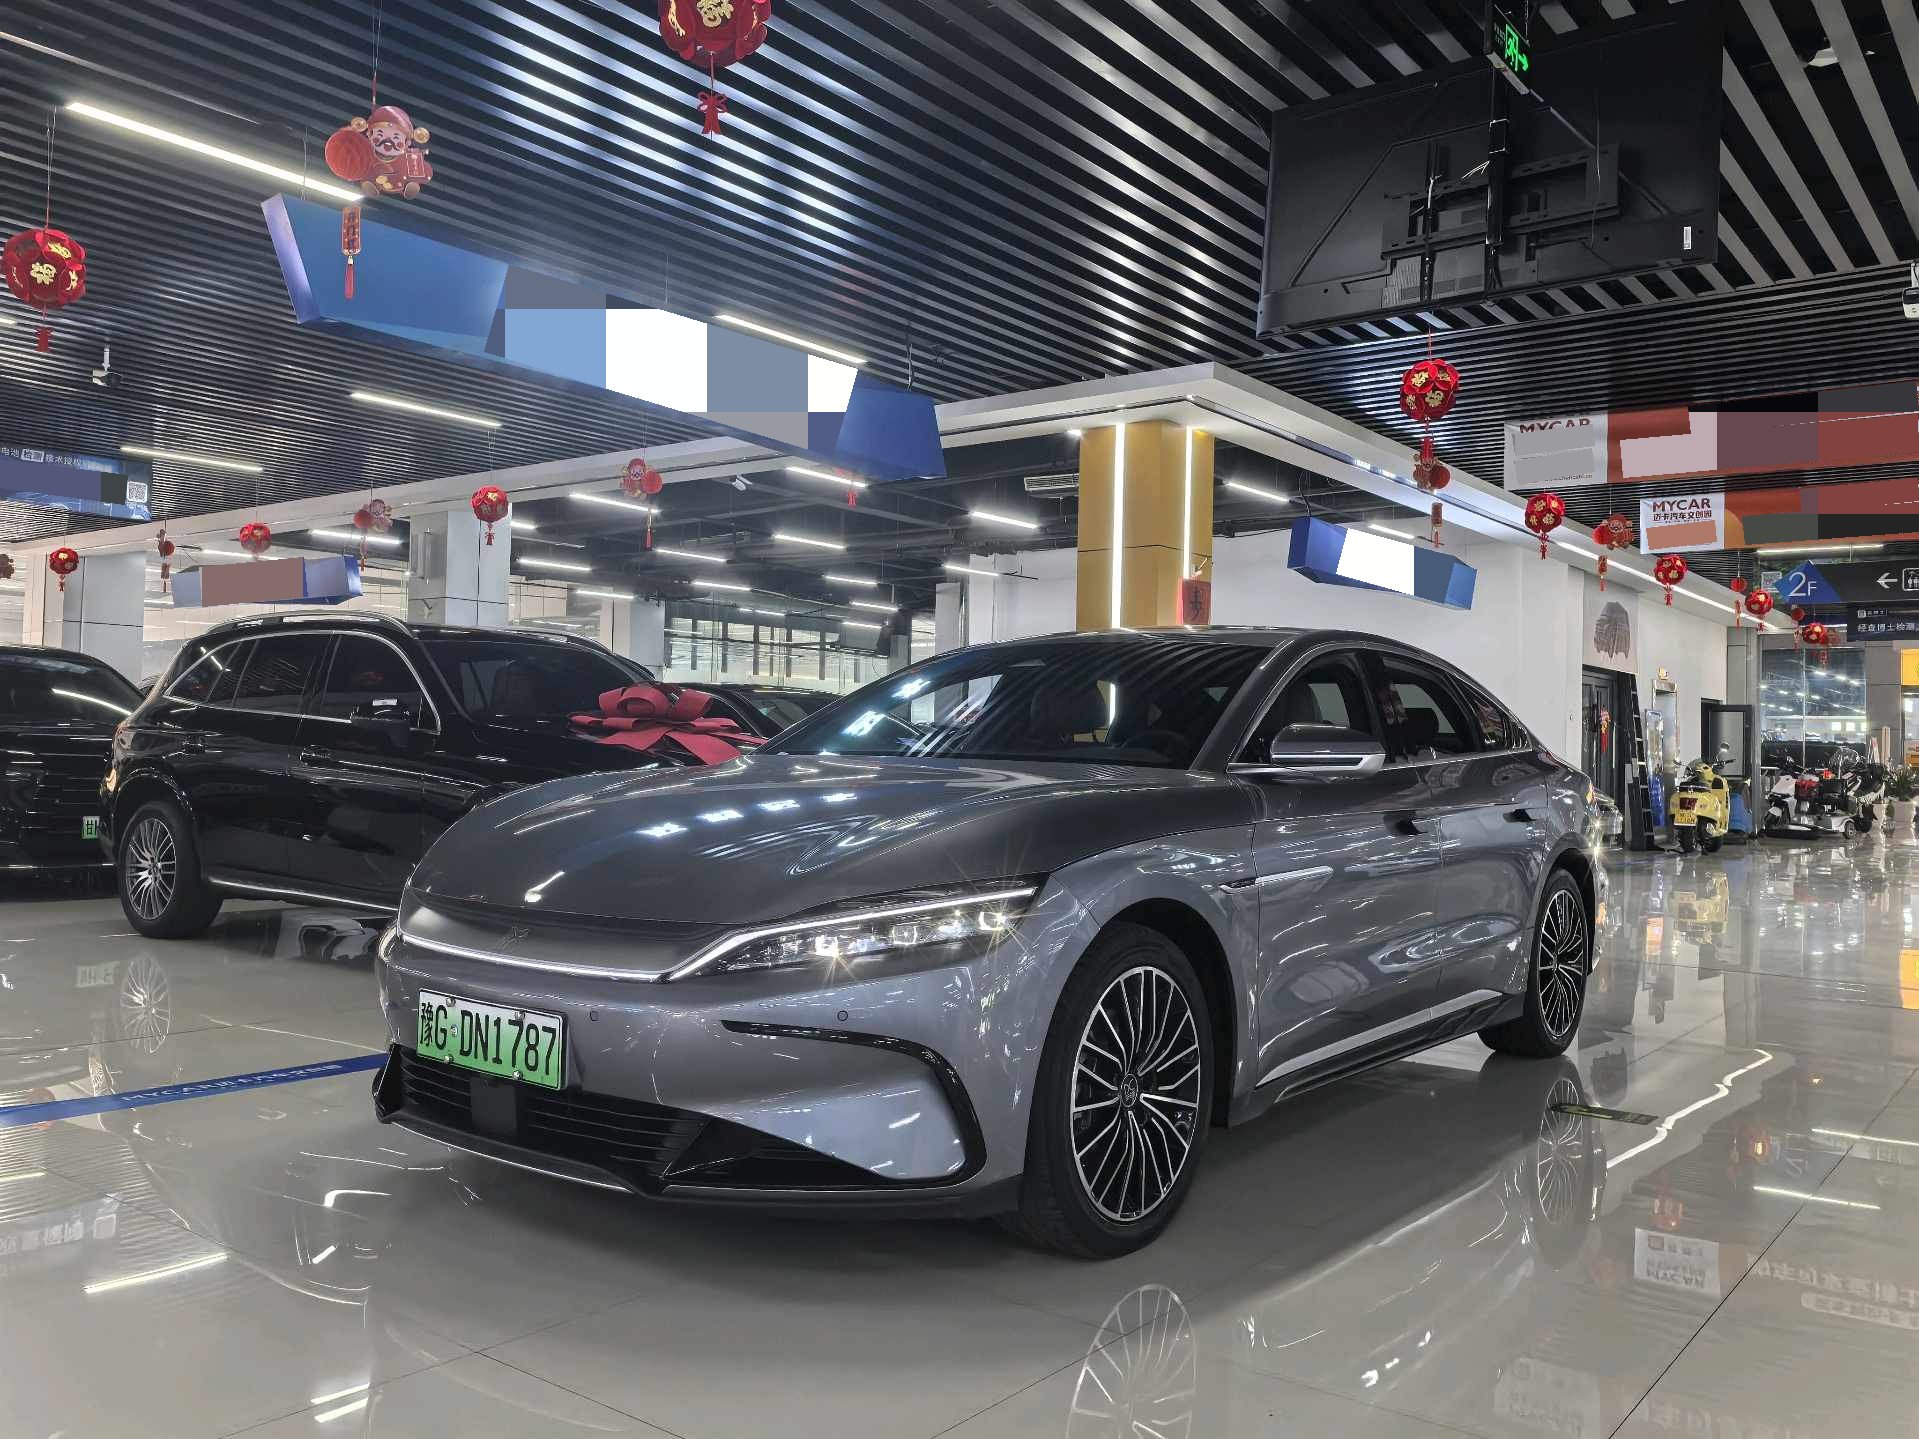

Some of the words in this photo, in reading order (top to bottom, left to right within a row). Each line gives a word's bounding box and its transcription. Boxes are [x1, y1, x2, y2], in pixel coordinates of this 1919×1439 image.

[1652, 498, 1711, 512] MYCAR
[1788, 572, 1817, 596] 2F
[1857, 623, 1919, 632] 经查博士检测
[86, 820, 97, 835] 甘
